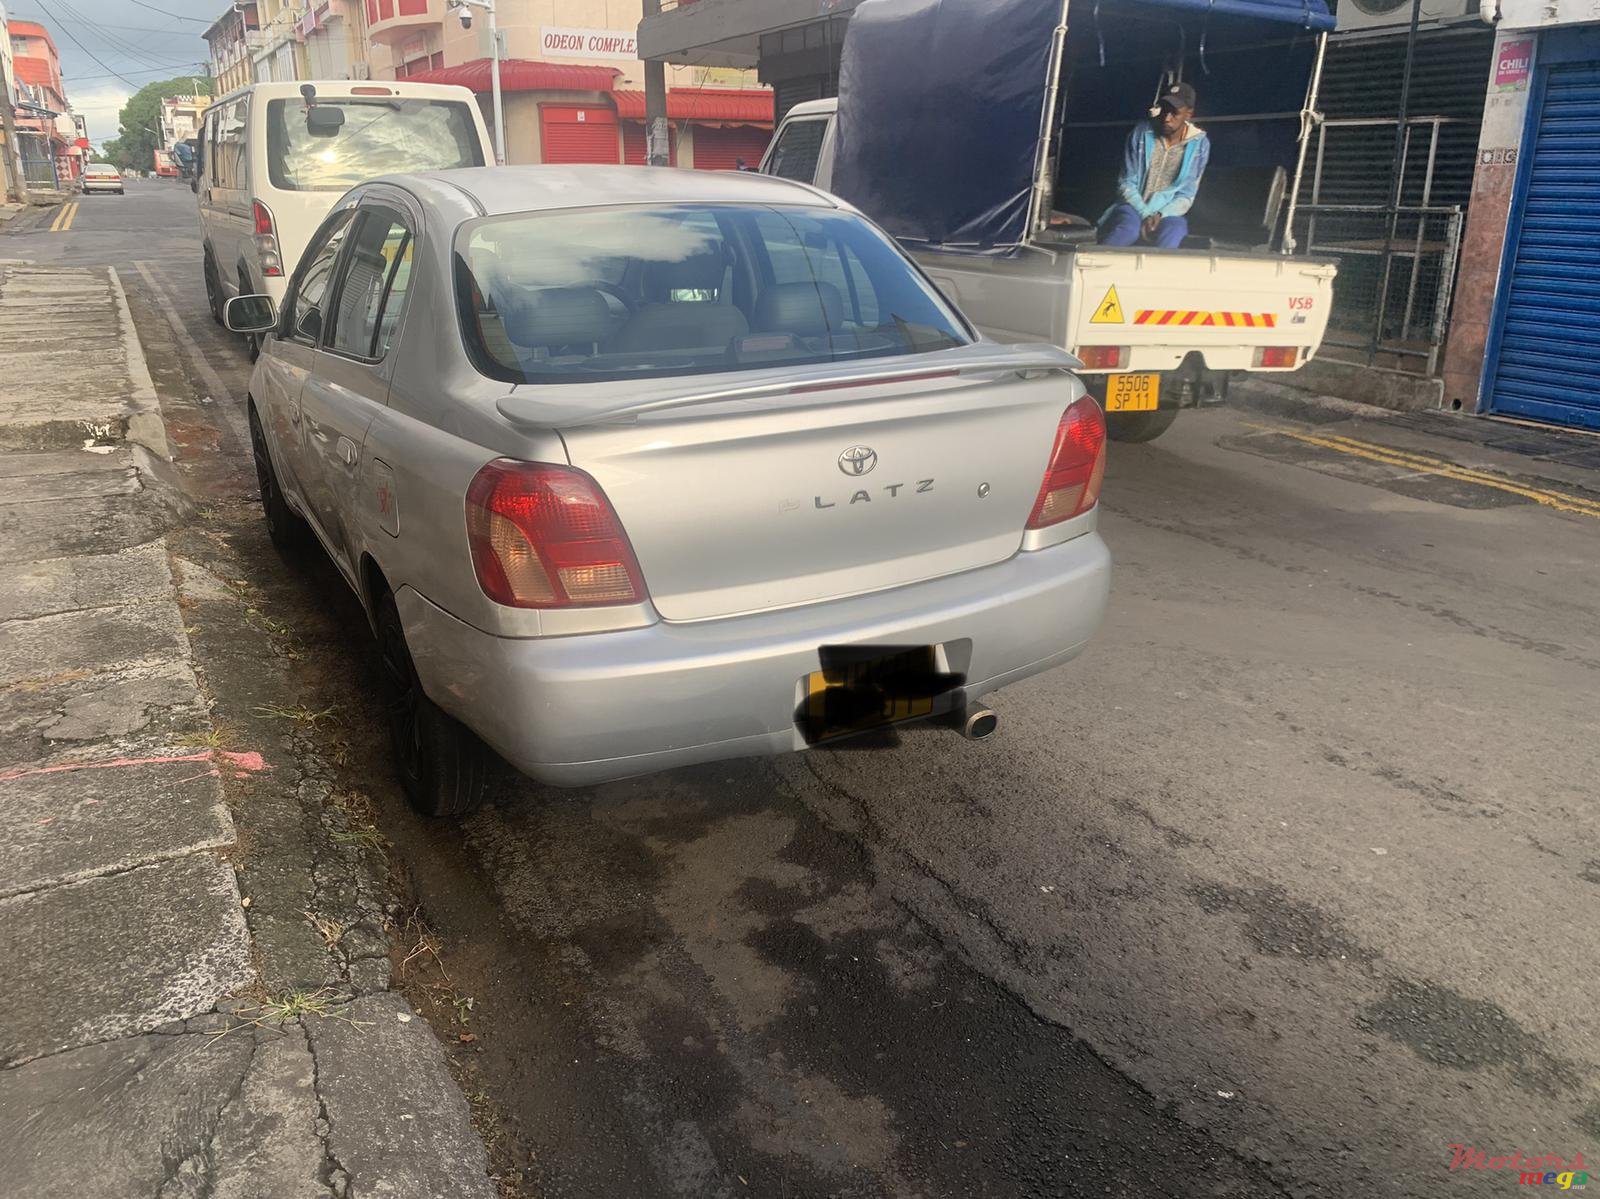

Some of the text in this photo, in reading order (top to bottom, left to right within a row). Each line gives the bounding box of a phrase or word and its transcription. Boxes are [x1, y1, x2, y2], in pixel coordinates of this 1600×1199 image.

[544, 33, 638, 54] ODEON COMPLE
[1499, 57, 1529, 70] CHILI
[1288, 297, 1313, 310] VSB
[1117, 375, 1150, 392] 5506
[1114, 393, 1149, 409] SP 11
